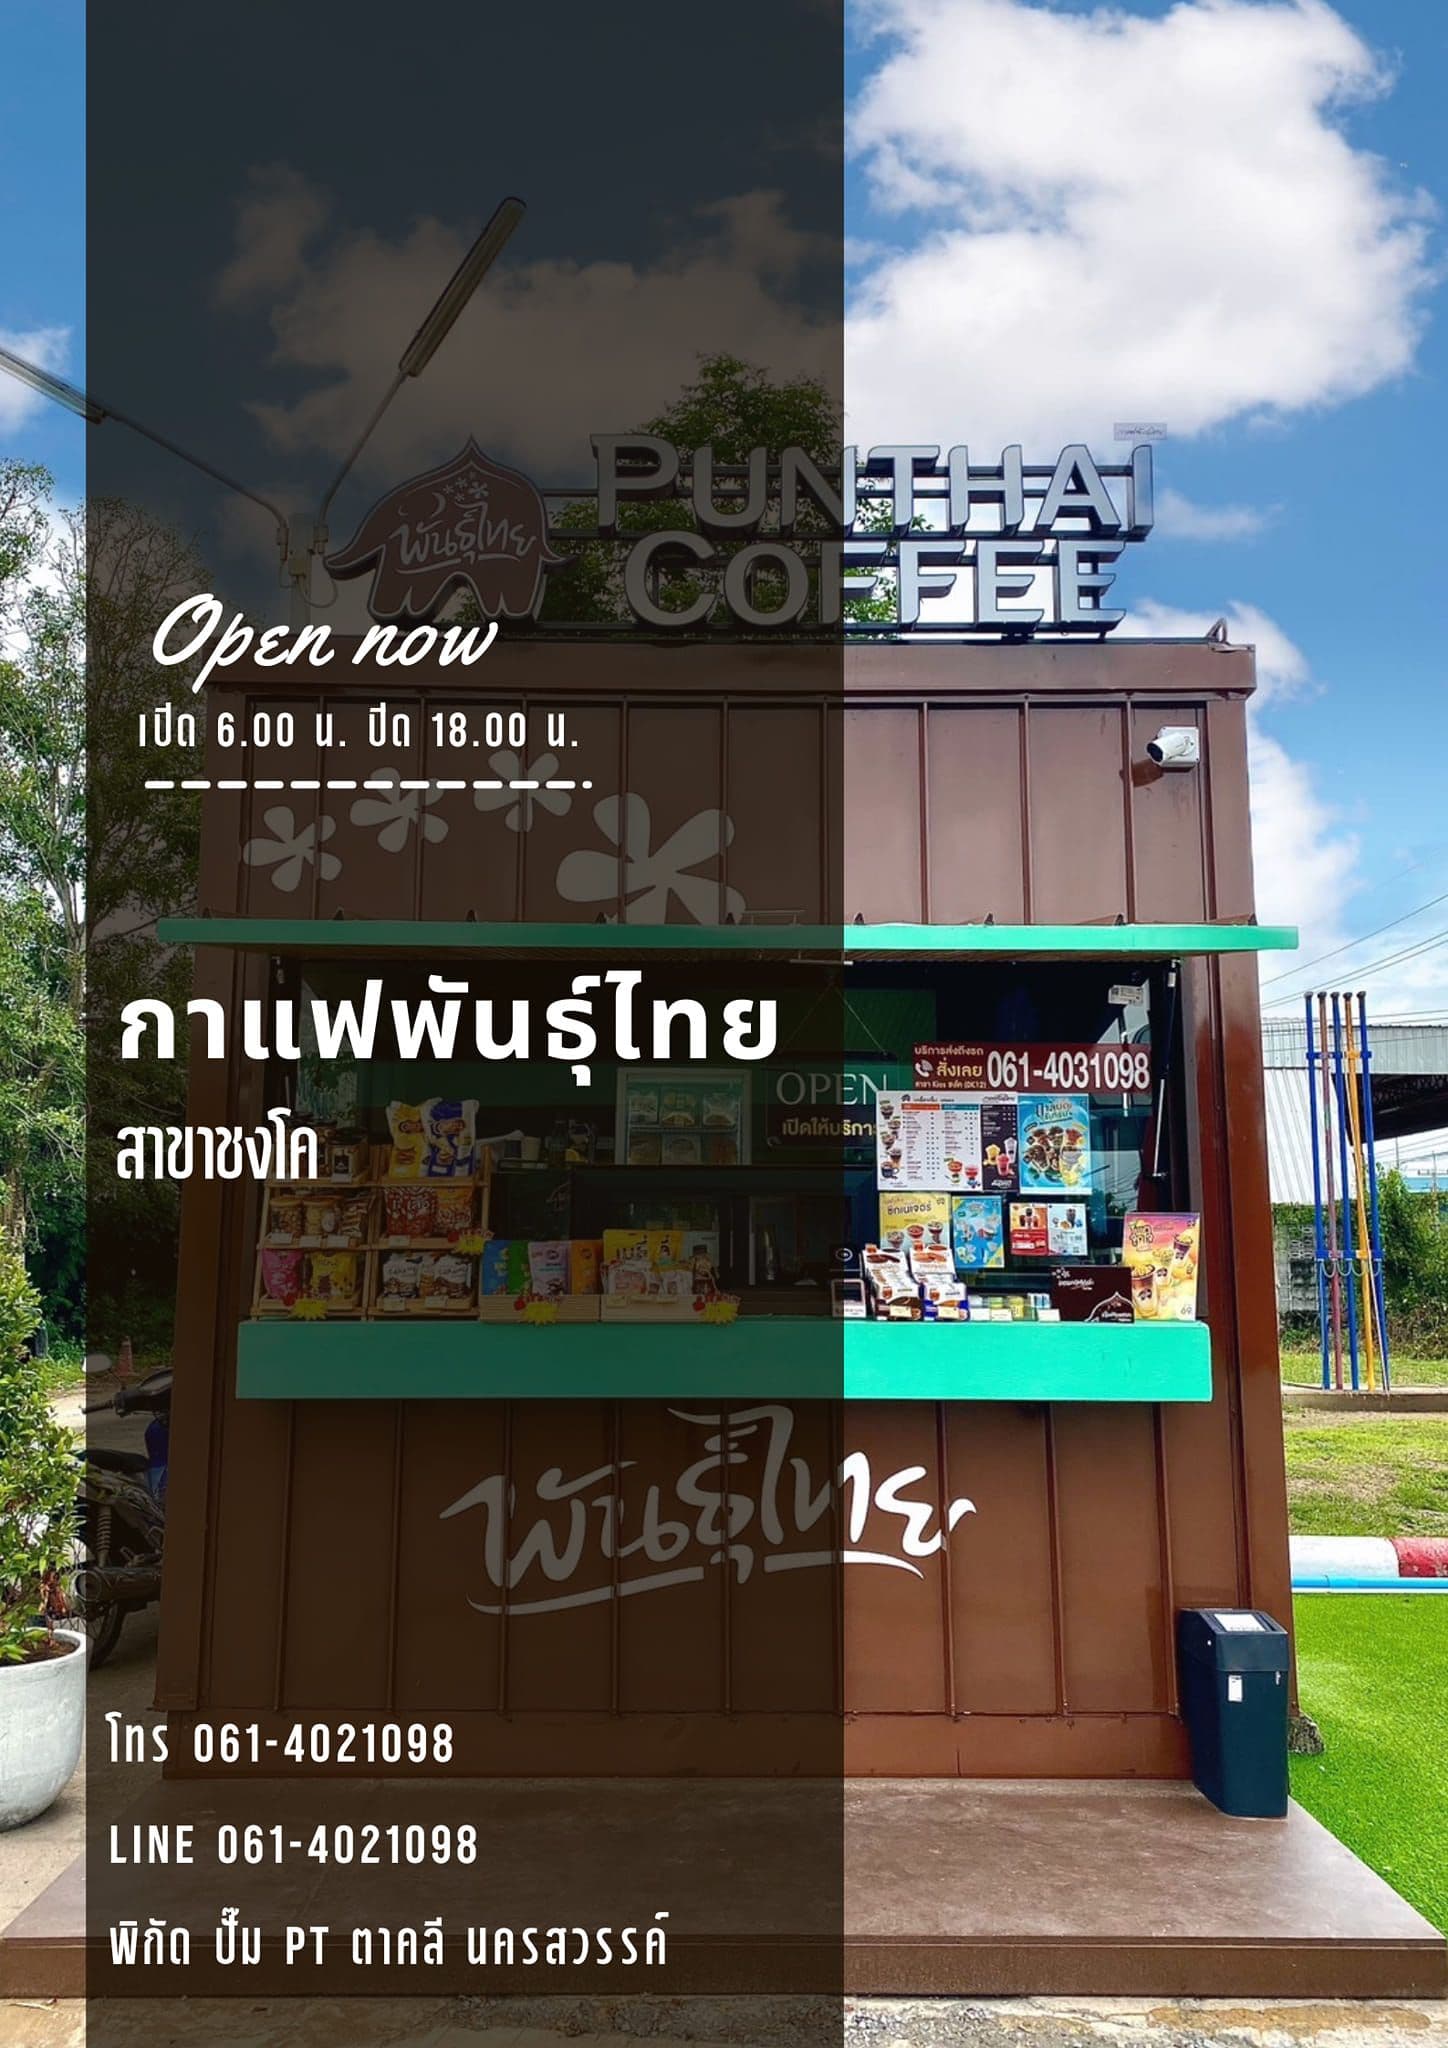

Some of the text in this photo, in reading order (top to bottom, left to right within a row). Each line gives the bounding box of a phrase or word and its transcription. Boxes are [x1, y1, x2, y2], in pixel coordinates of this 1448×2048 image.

[592, 433, 1155, 538] PUNTHAI
[625, 533, 1126, 632] COFFEE
[936, 1056, 983, 1078] สั่งเลย
[987, 1050, 1151, 1090] 061-4031098
[775, 1071, 887, 1107] OPEN
[781, 1115, 877, 1137] เปิดให้บริกา
[439, 1404, 977, 1616] พันธุ์ไทย
